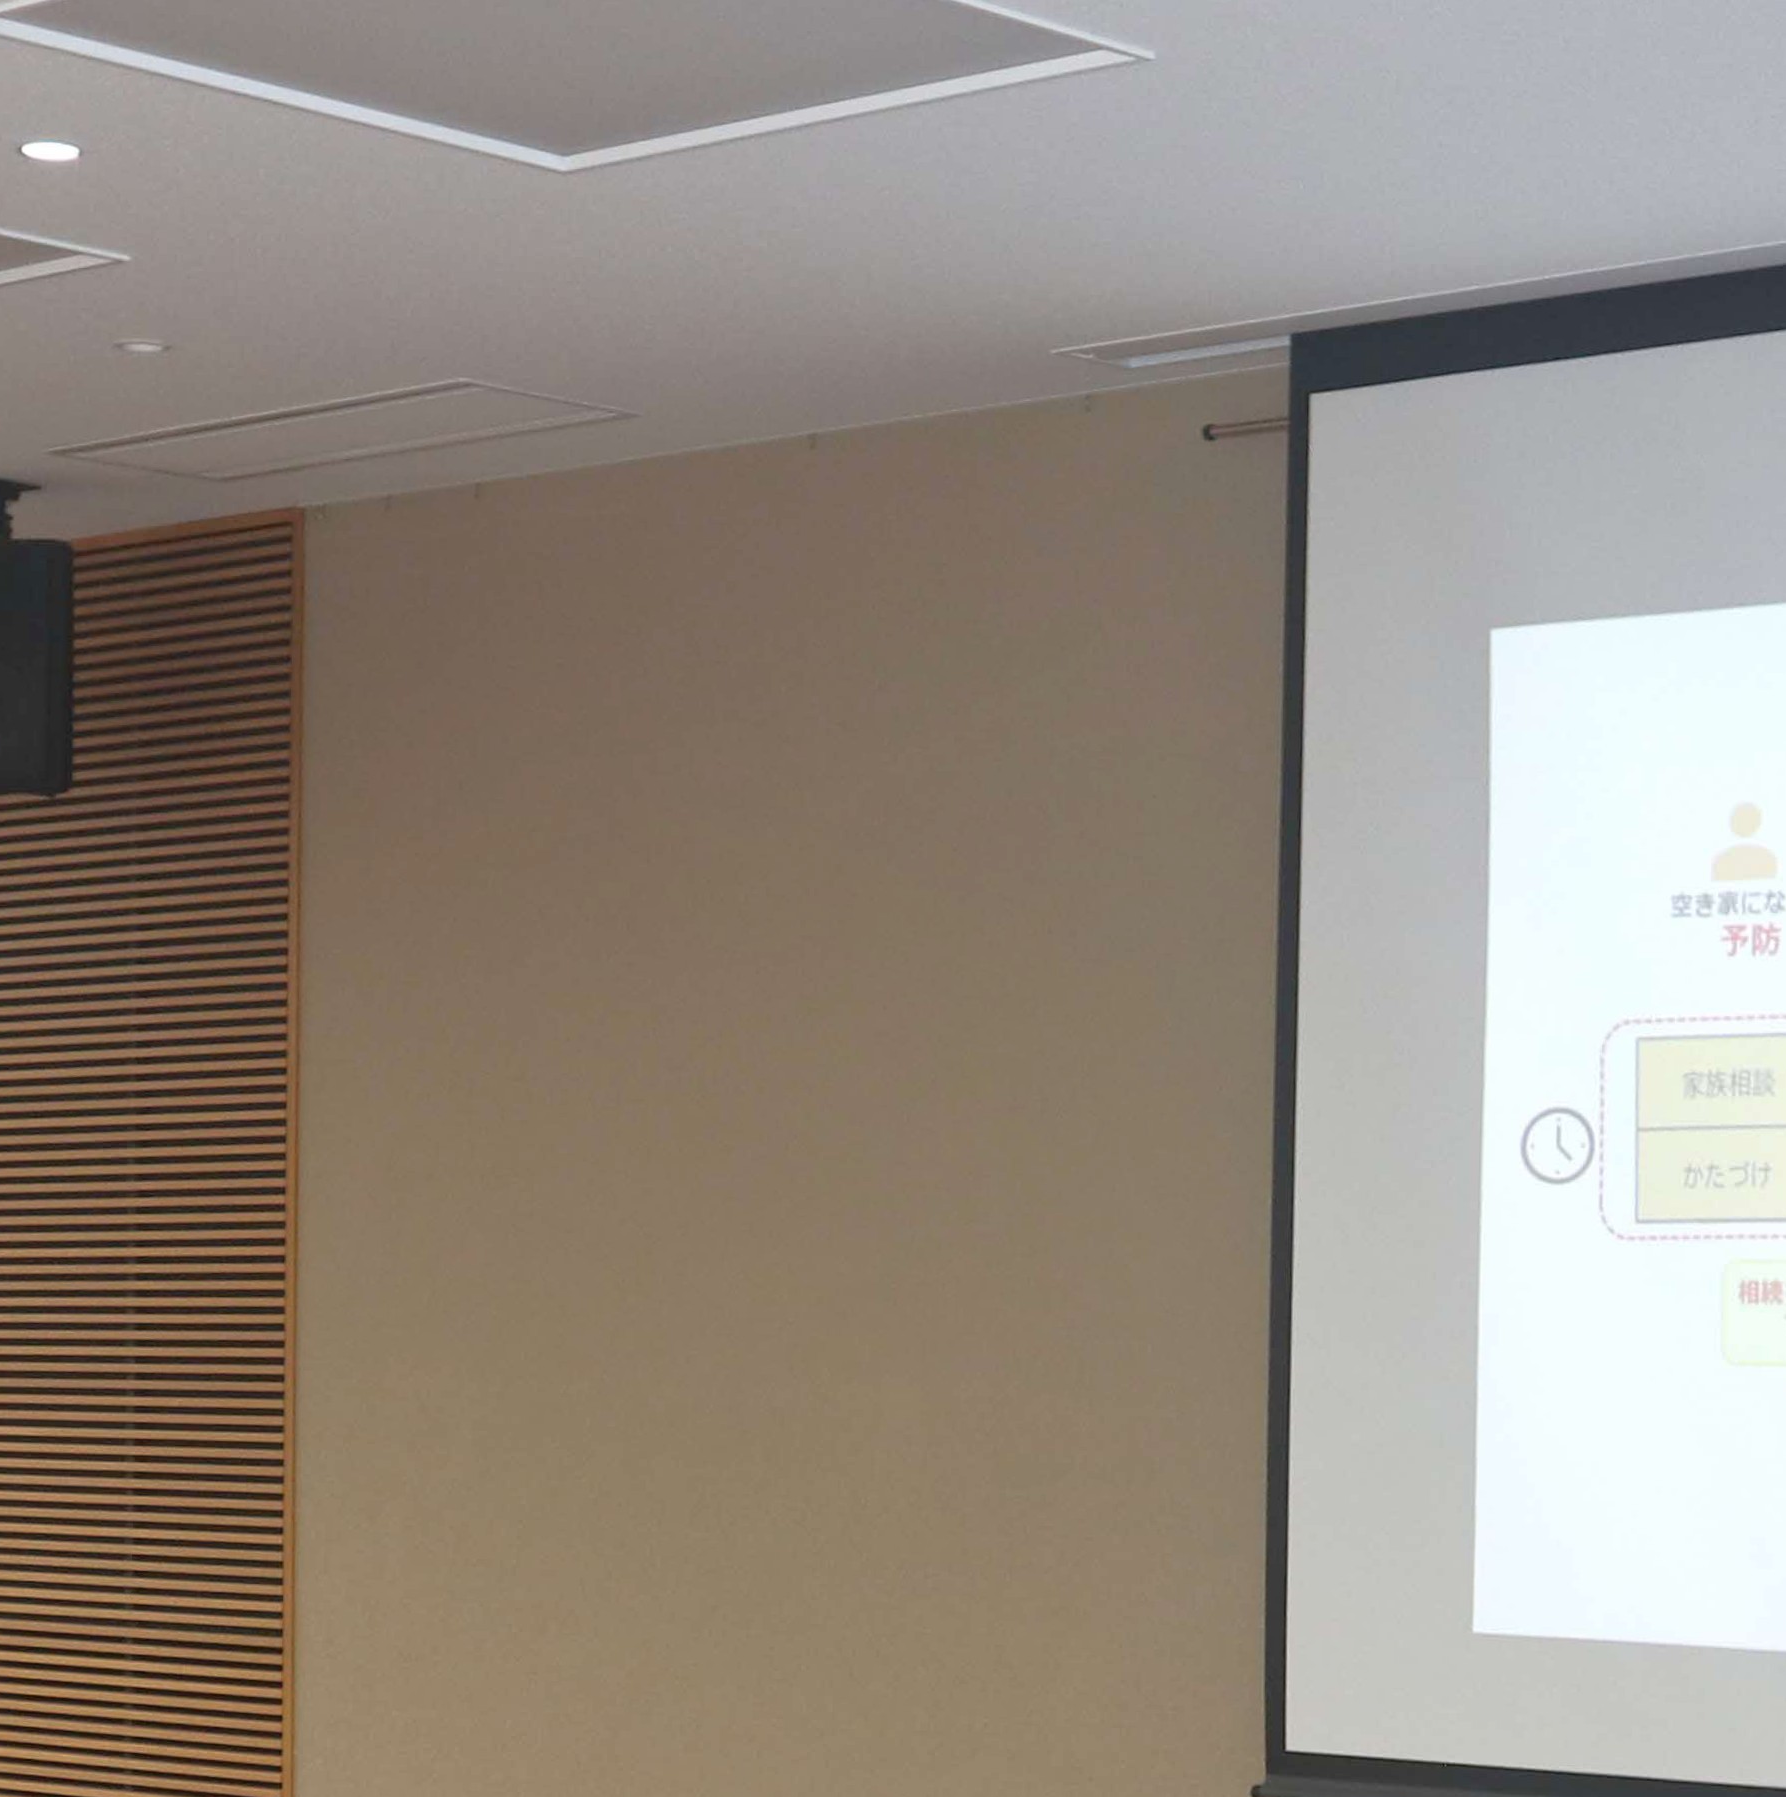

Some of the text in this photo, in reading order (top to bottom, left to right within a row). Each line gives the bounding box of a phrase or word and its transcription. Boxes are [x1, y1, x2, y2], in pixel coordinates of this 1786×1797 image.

[1721, 924, 1781, 957] 予防
[1682, 1068, 1777, 1099] 家族相談
[1682, 1160, 1772, 1191] かたづけ
